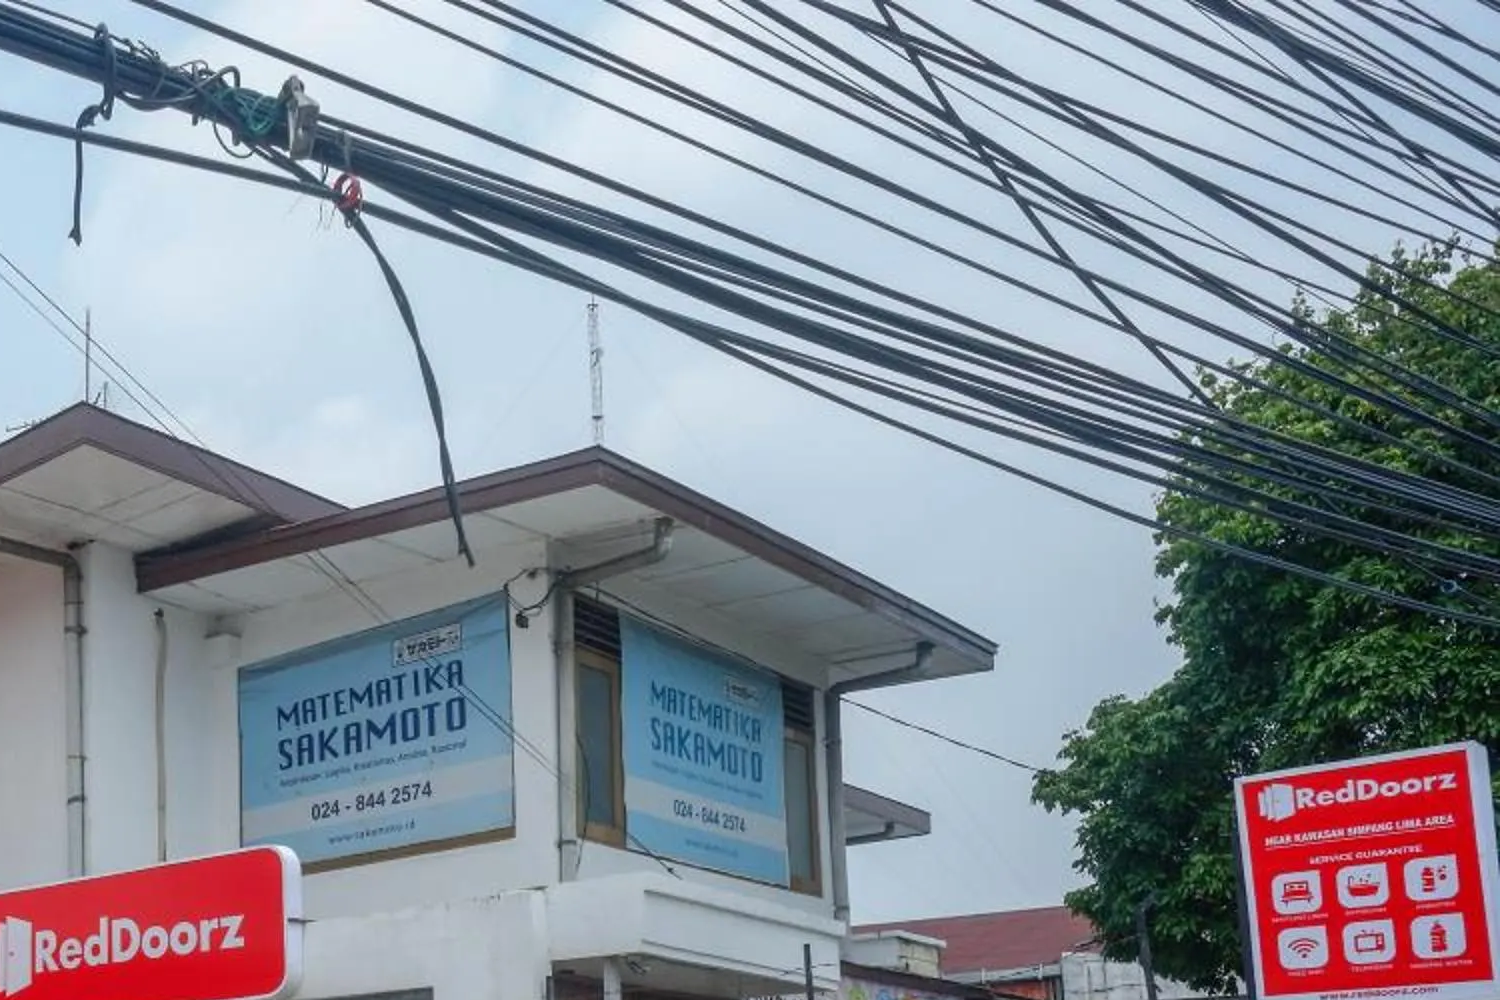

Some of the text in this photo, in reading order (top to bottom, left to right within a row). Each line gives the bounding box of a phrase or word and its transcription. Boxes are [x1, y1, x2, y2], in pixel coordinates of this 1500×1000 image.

[276, 659, 464, 732] MATEMATIKA
[650, 680, 761, 744] MATEMATIKA
[277, 697, 467, 771] SAKAMOTO
[650, 717, 764, 783] SAKAMOTO
[311, 799, 341, 820] 024
[356, 790, 387, 811] 844
[391, 781, 433, 805] 2574
[1295, 771, 1458, 810] RedDoorz
[673, 799, 694, 819] 024
[701, 807, 720, 826] 844
[722, 812, 747, 833] 2574
[1264, 835, 1293, 847] NEAR
[1294, 828, 1346, 843] KAWASAN
[1347, 821, 1394, 836] SIMPANG
[1424, 814, 1455, 827] AREA
[1308, 844, 1423, 865] SERVICE GUARANTEE
[35, 913, 245, 974] RedDoorz
